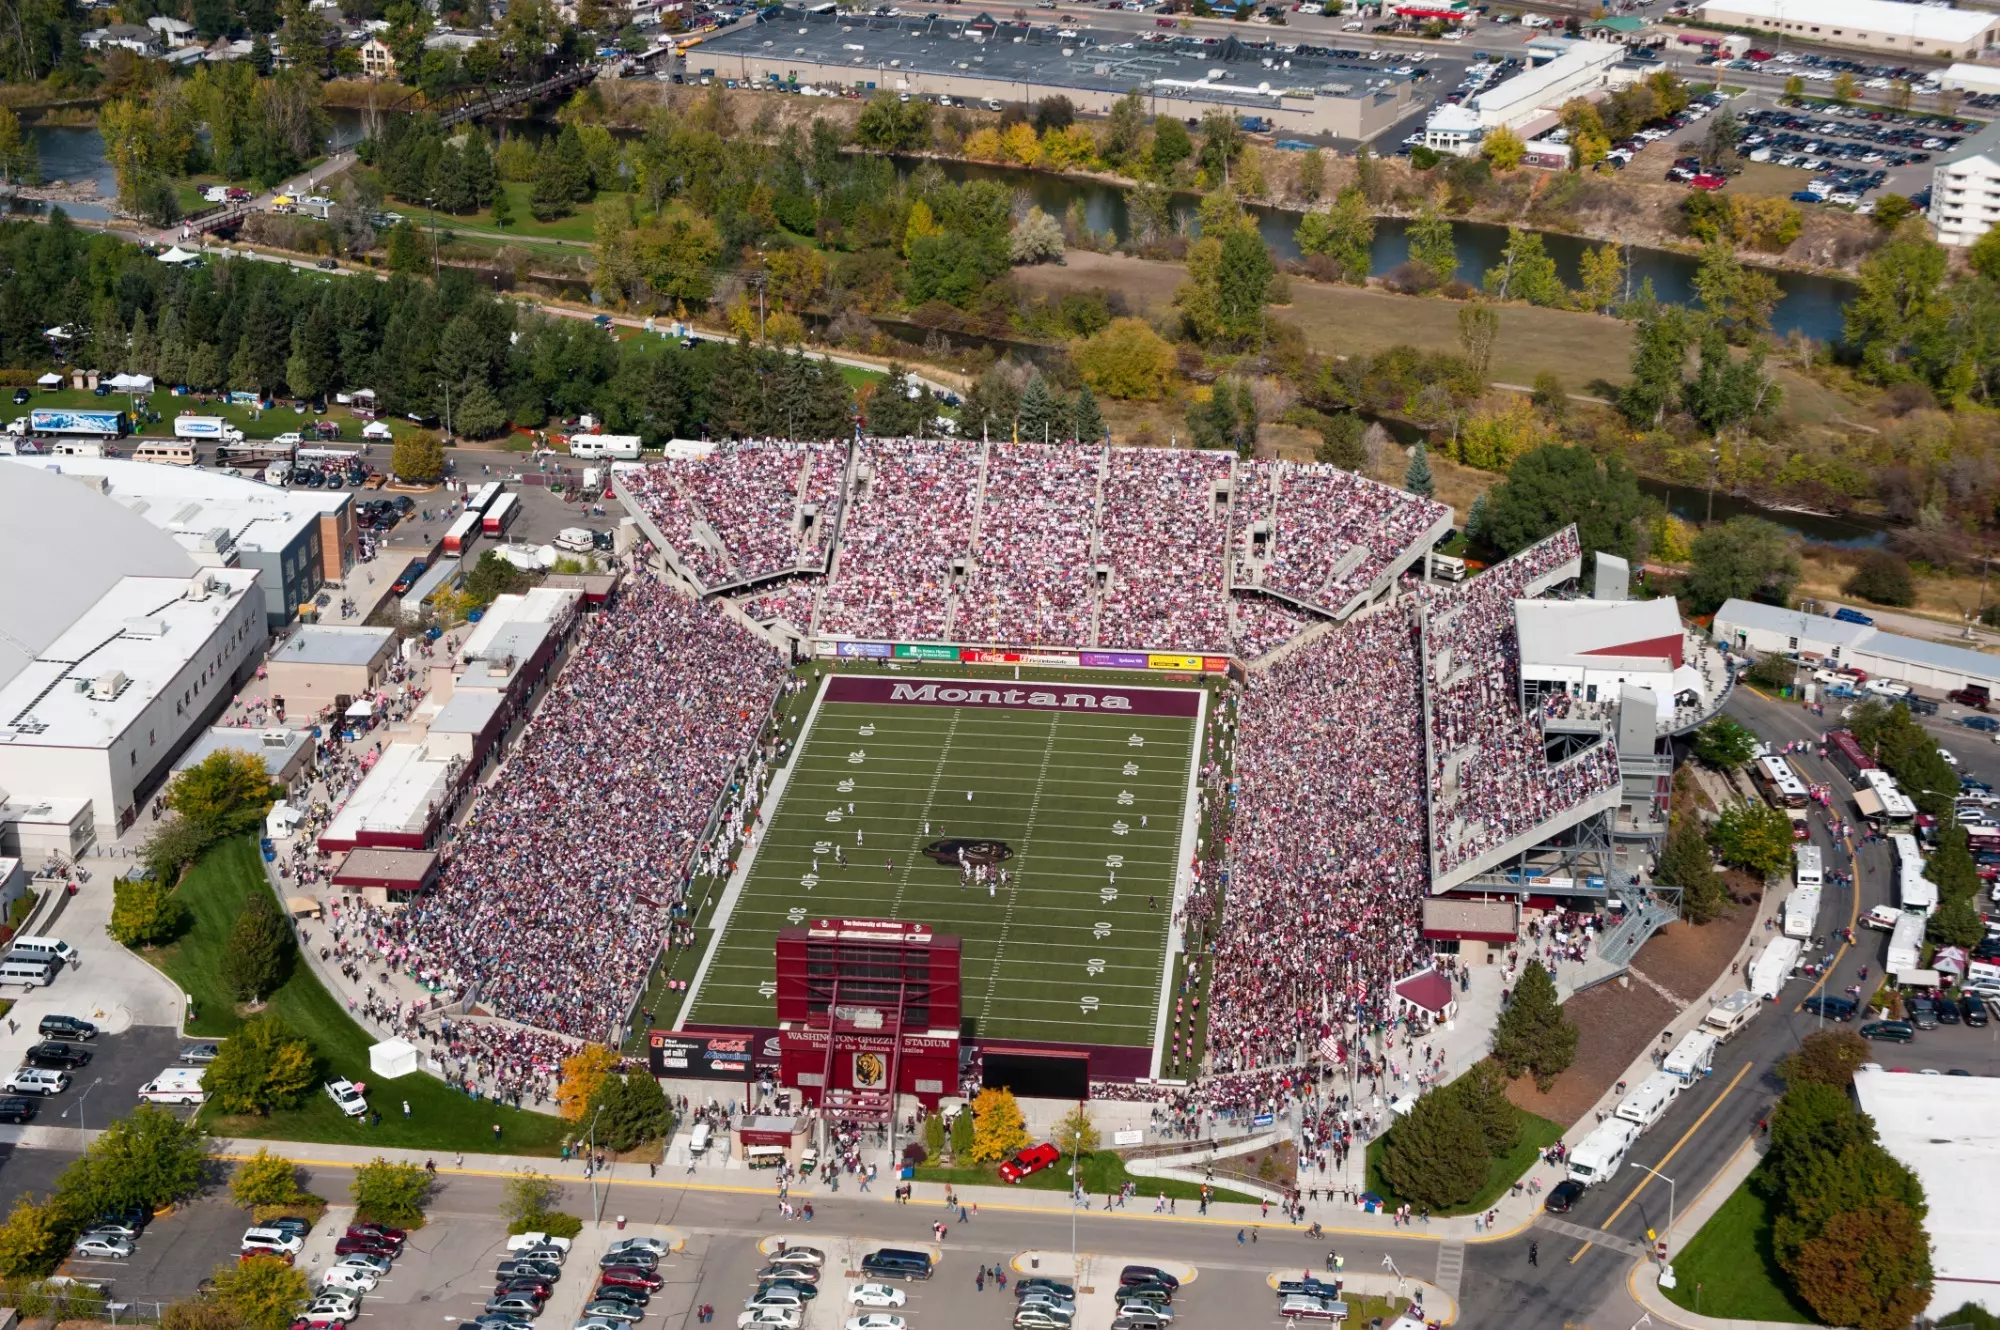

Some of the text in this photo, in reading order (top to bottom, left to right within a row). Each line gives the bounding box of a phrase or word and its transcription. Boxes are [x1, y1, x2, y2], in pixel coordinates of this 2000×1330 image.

[890, 683, 1132, 710] Montana
[1105, 854, 1124, 868] 50
[1100, 887, 1118, 901] 40
[852, 920, 876, 928] University
[882, 921, 903, 929] Montana
[1093, 922, 1112, 936] 30
[1087, 958, 1106, 973] 20
[1080, 996, 1100, 1011] 10
[707, 1039, 747, 1052] Coca-Cola
[787, 1031, 950, 1048] WASHINTON-GRIZZL STADIUM
[663, 1048, 687, 1058] got milk?
[859, 1044, 891, 1052] Montana
